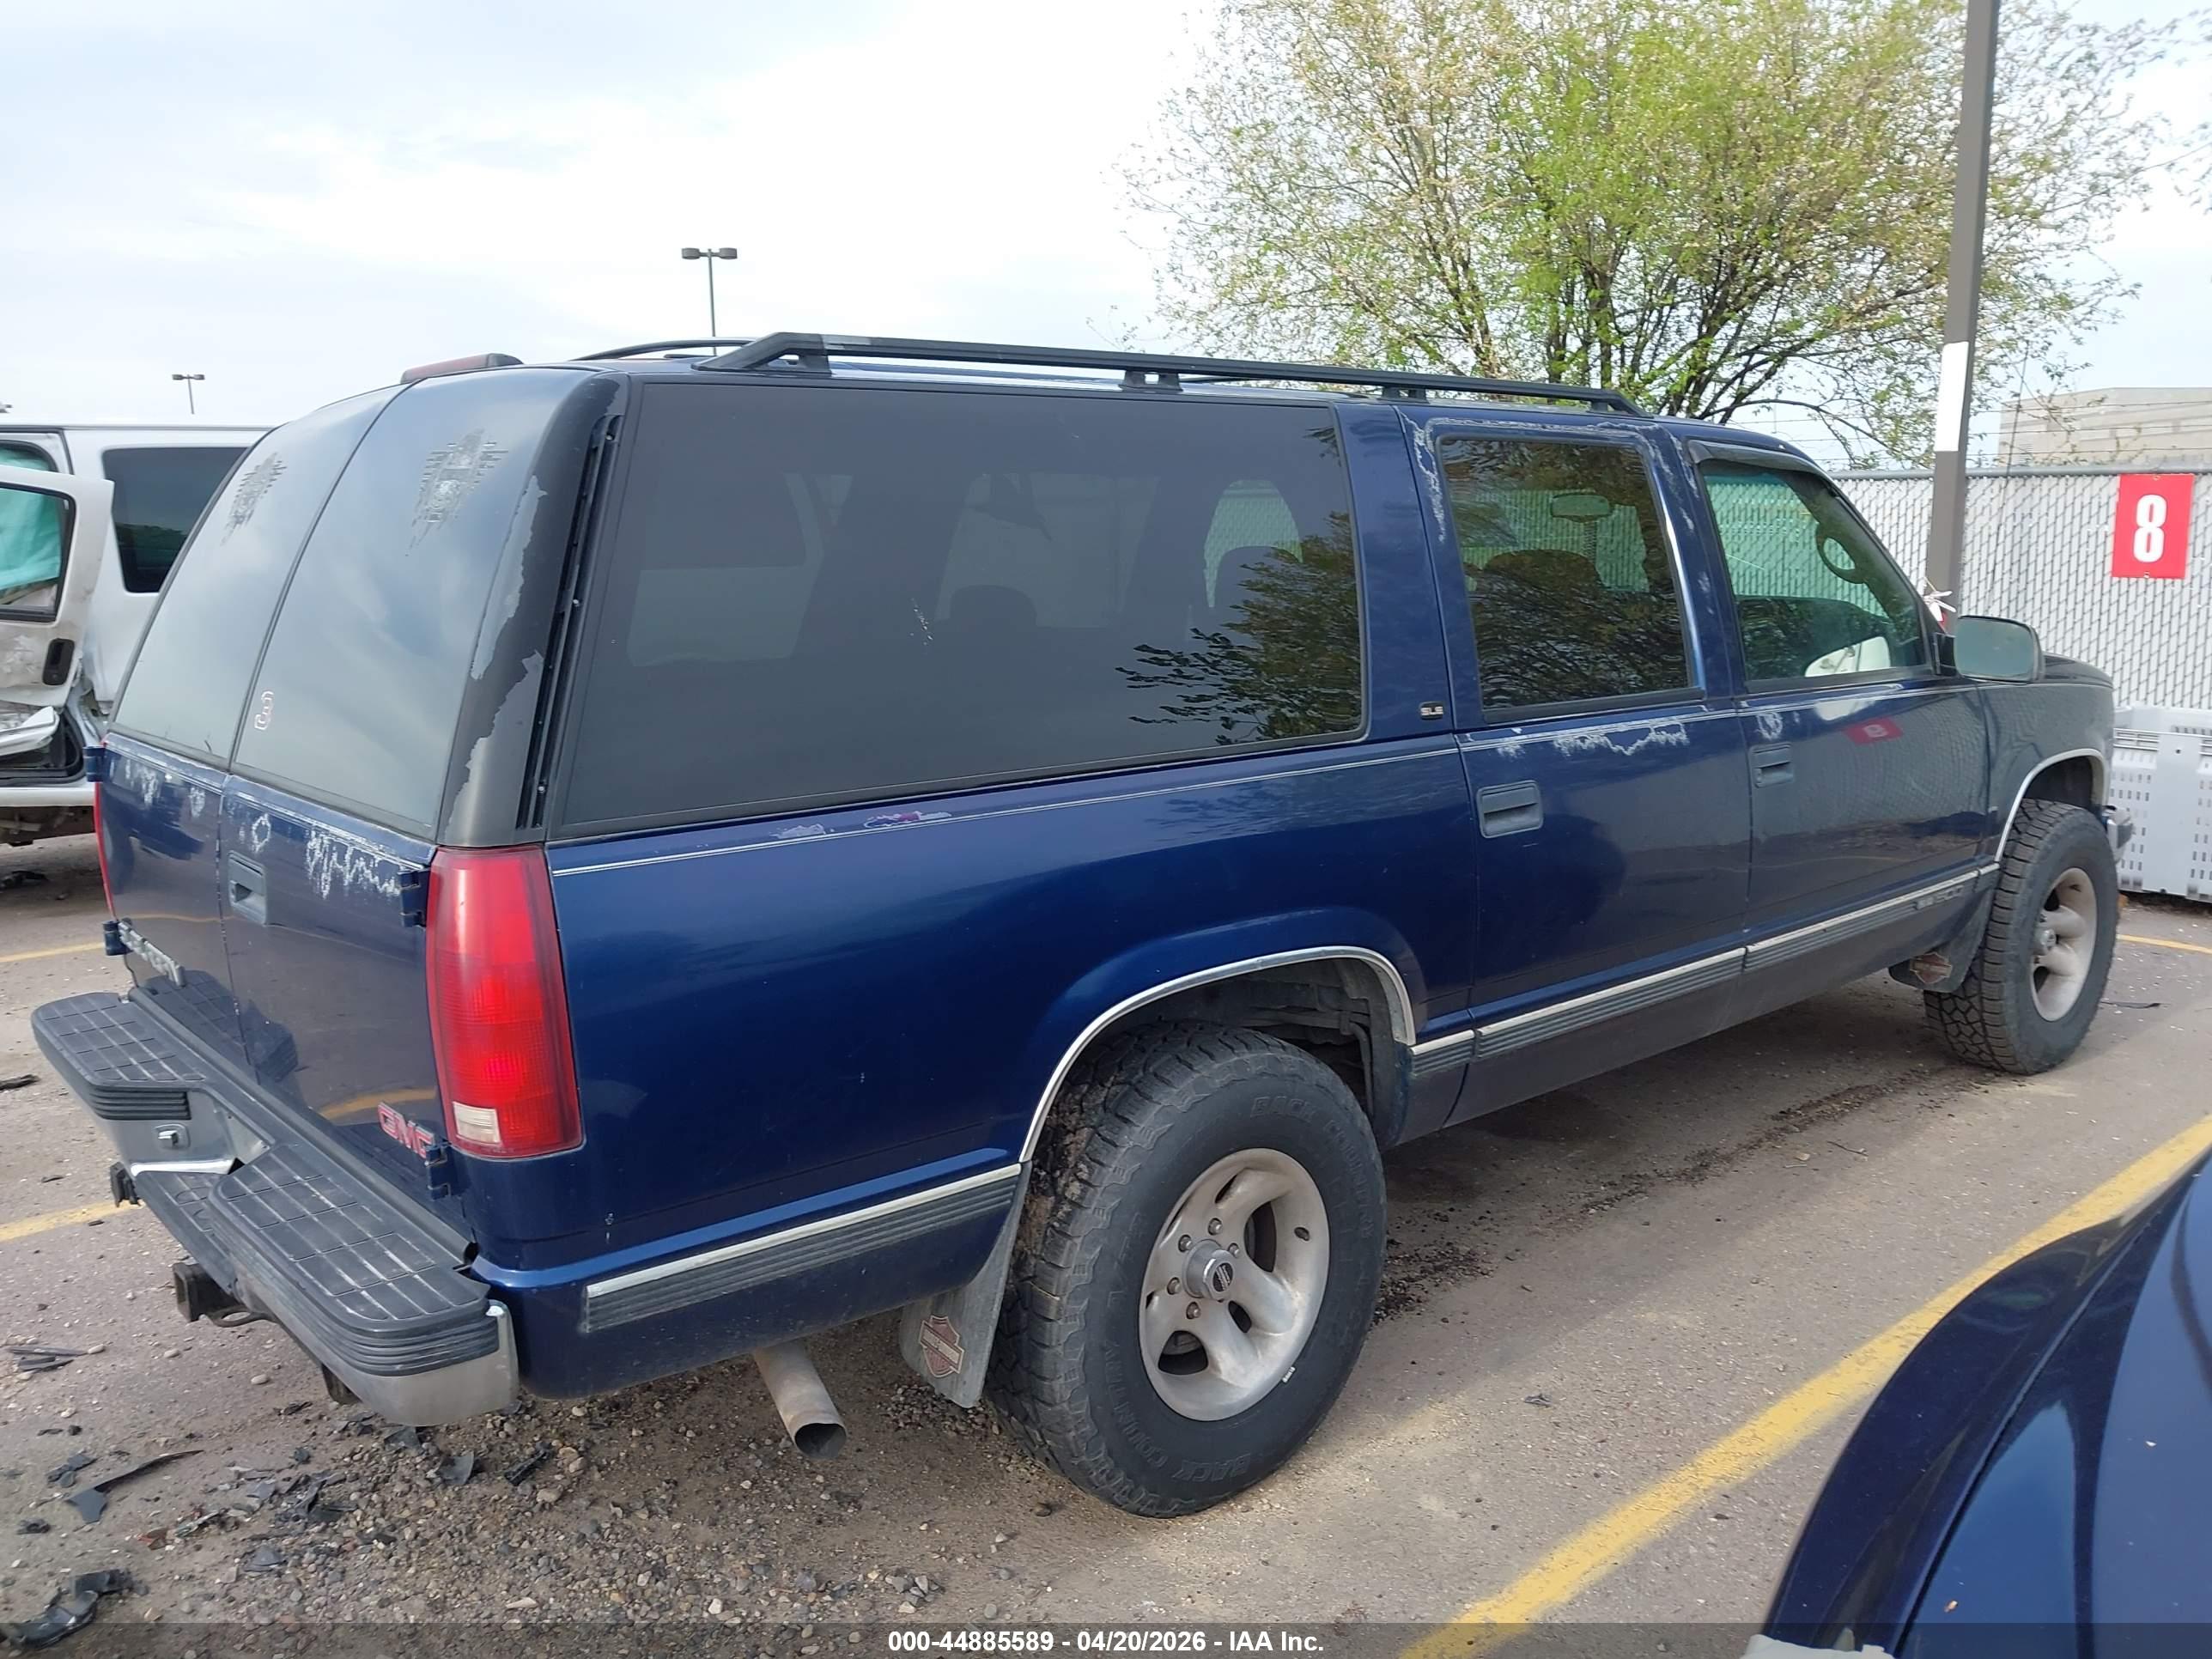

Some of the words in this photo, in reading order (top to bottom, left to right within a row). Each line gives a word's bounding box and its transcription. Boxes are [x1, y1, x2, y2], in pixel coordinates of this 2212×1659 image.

[2133, 494, 2167, 562] 8
[378, 1102, 434, 1159] GMC
[1250, 1095, 1316, 1124] BACK
